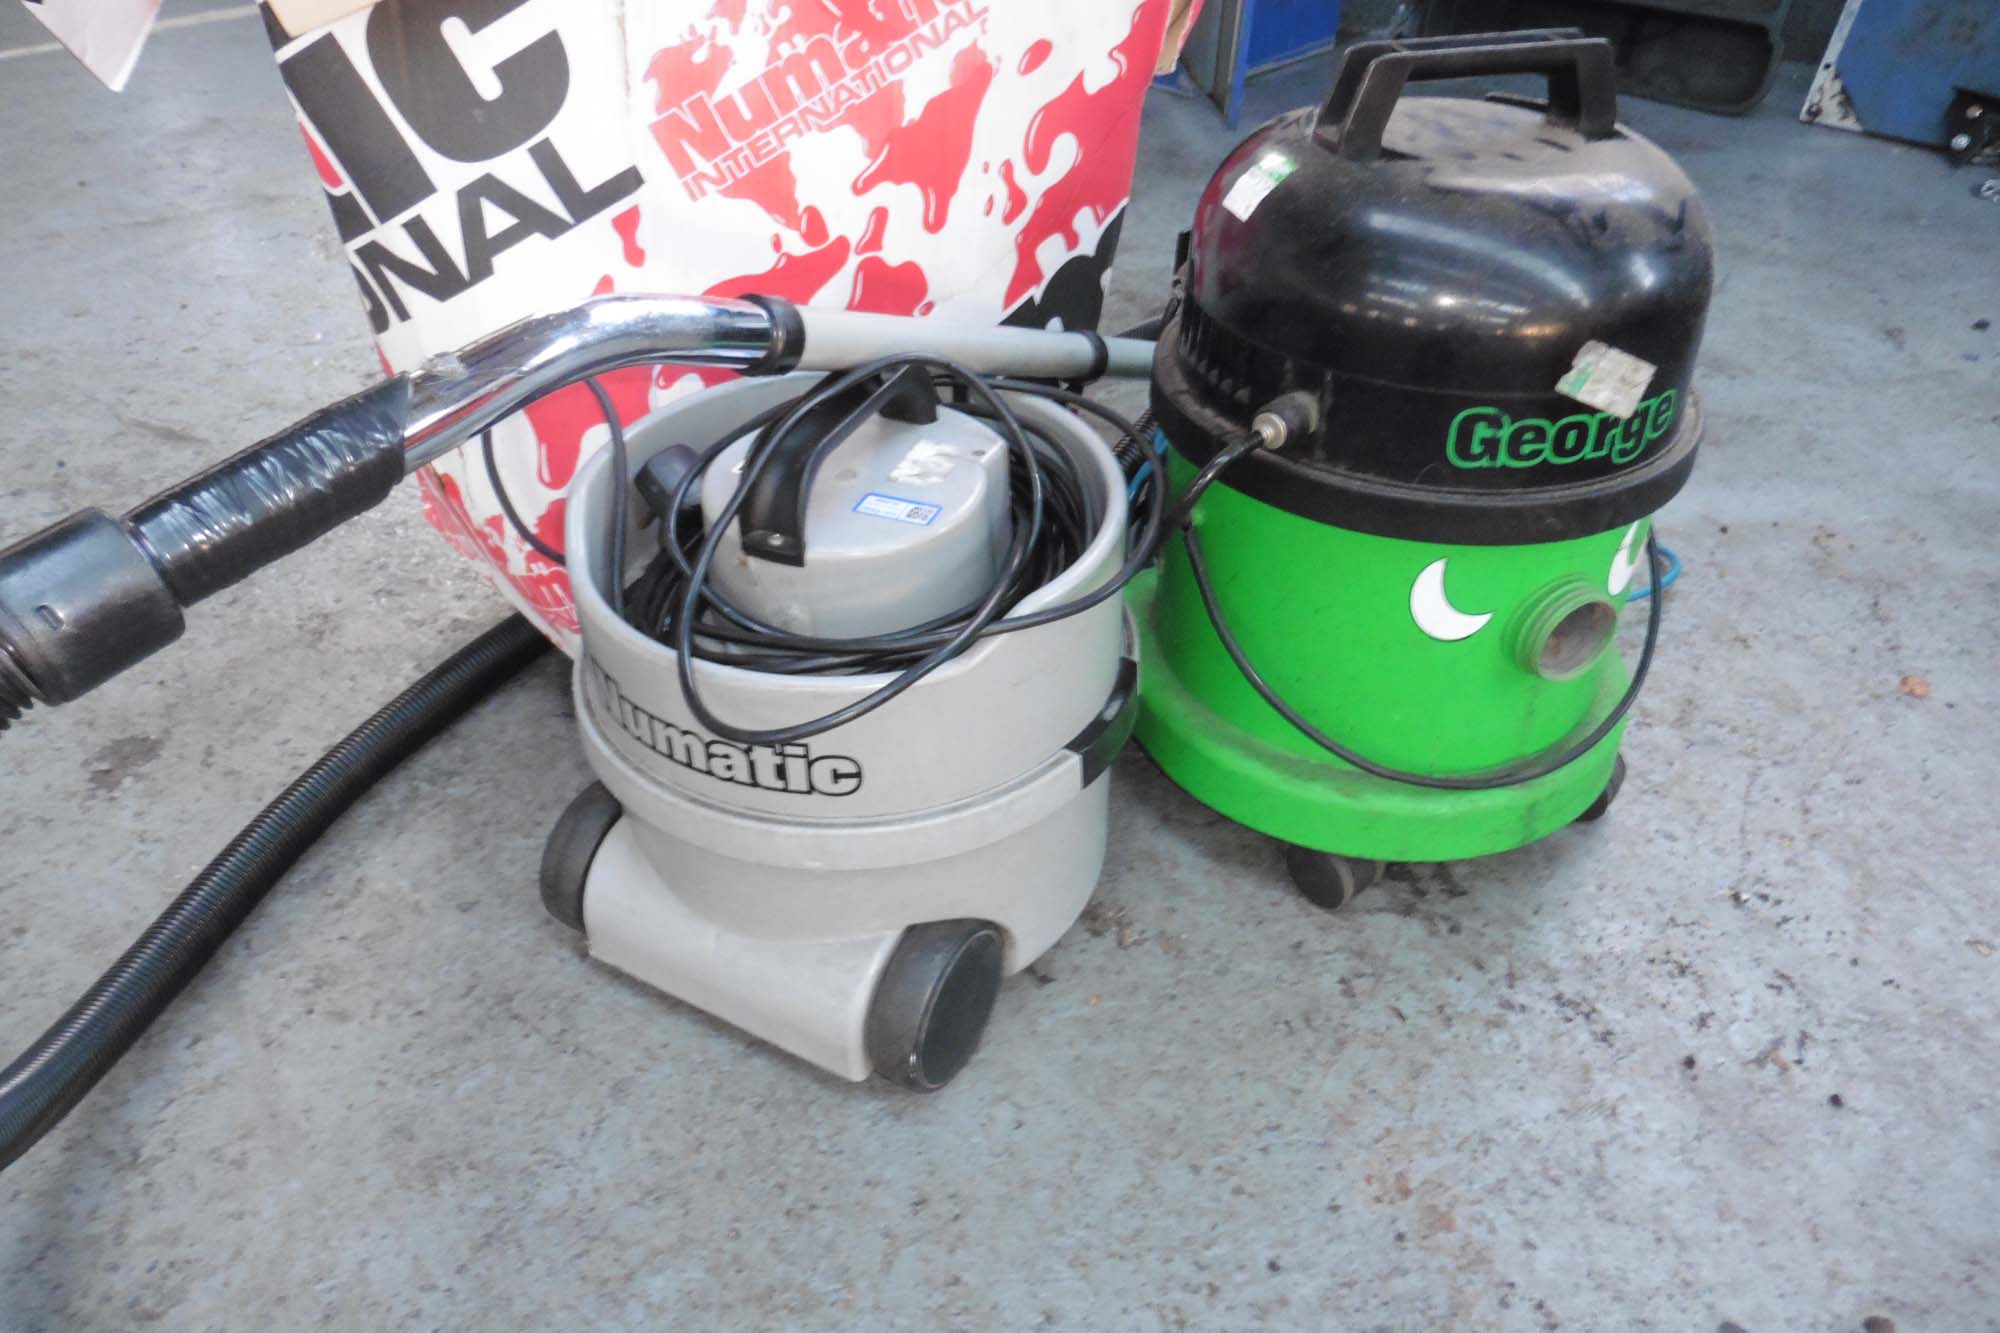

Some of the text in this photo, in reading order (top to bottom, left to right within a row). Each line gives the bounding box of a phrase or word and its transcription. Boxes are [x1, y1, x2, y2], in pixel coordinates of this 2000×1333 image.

[264, 0, 570, 243] IC
[681, 0, 990, 202] INTERNATIONAL
[1446, 388, 1678, 468] George
